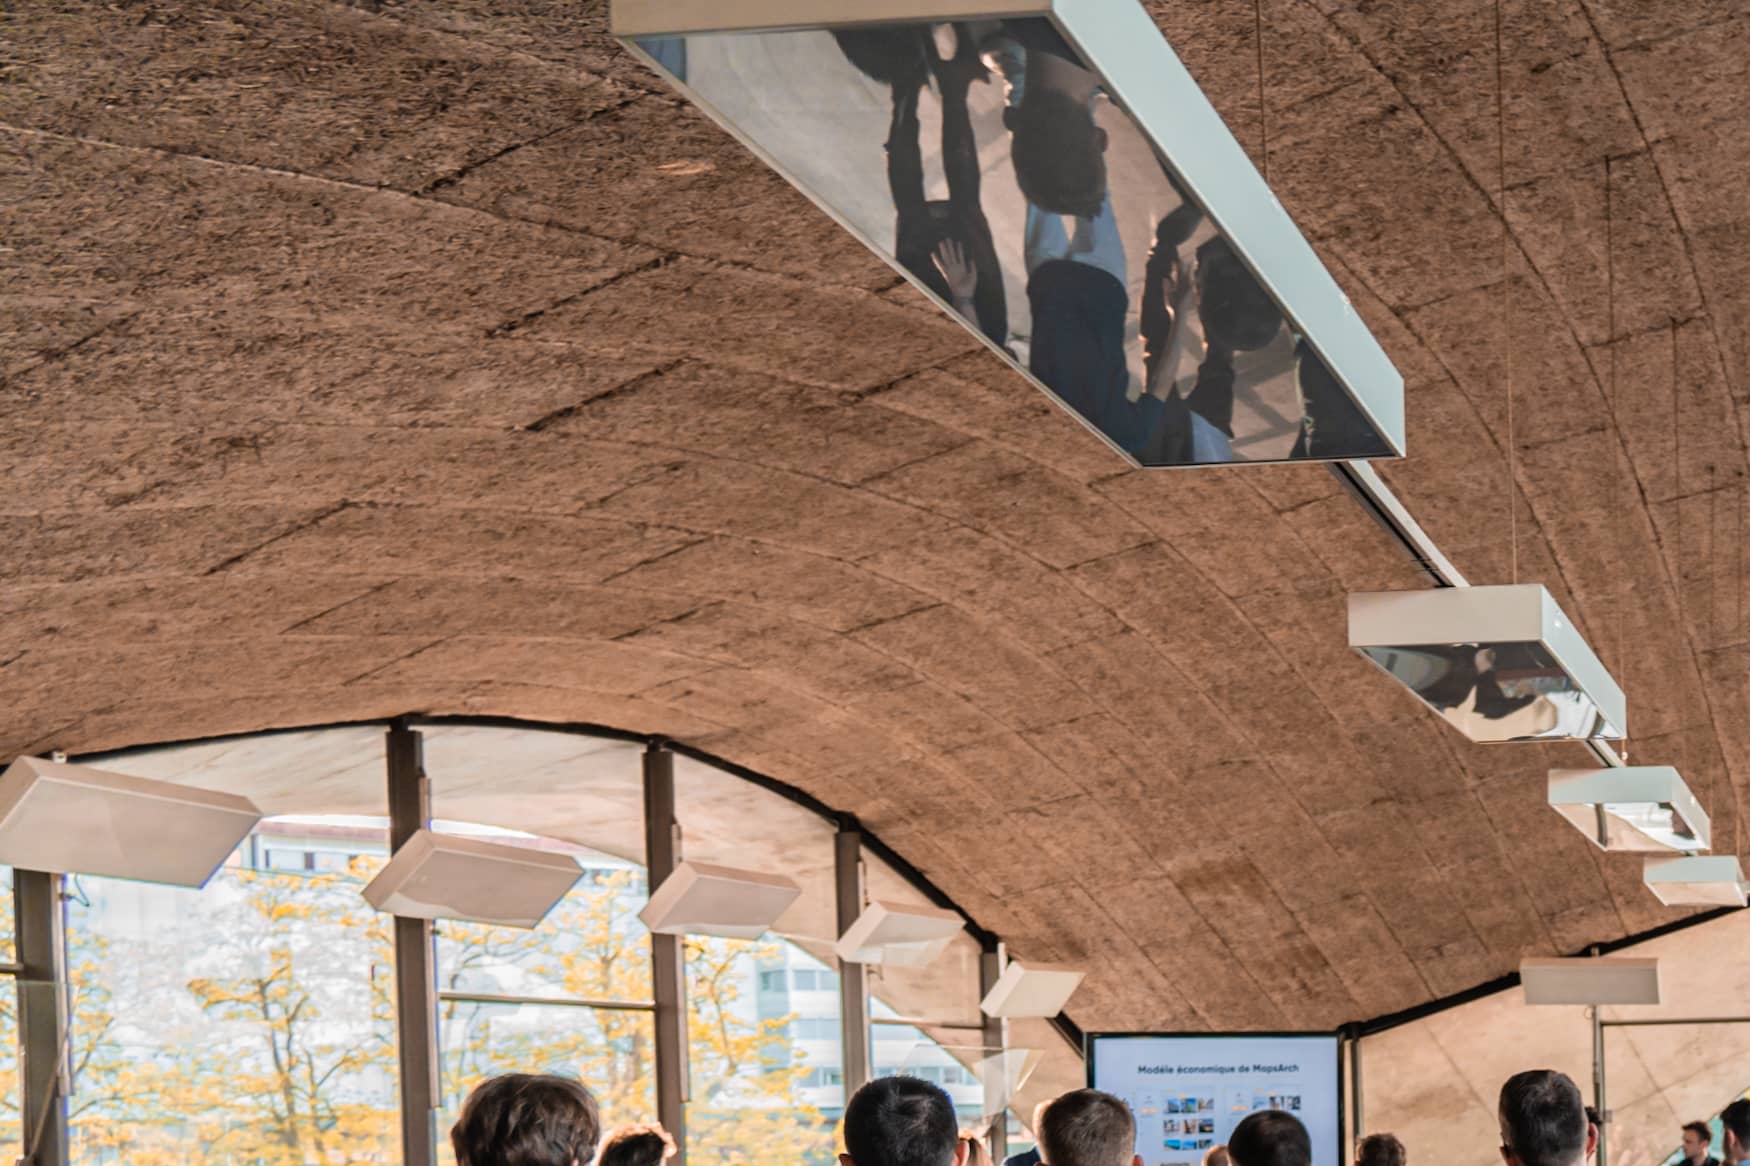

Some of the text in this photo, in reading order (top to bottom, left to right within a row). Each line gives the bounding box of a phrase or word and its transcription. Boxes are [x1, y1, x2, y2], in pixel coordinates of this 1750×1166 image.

[1138, 1064, 1174, 1075] Modèle
[1177, 1064, 1235, 1076] économique
[1238, 1064, 1250, 1074] de
